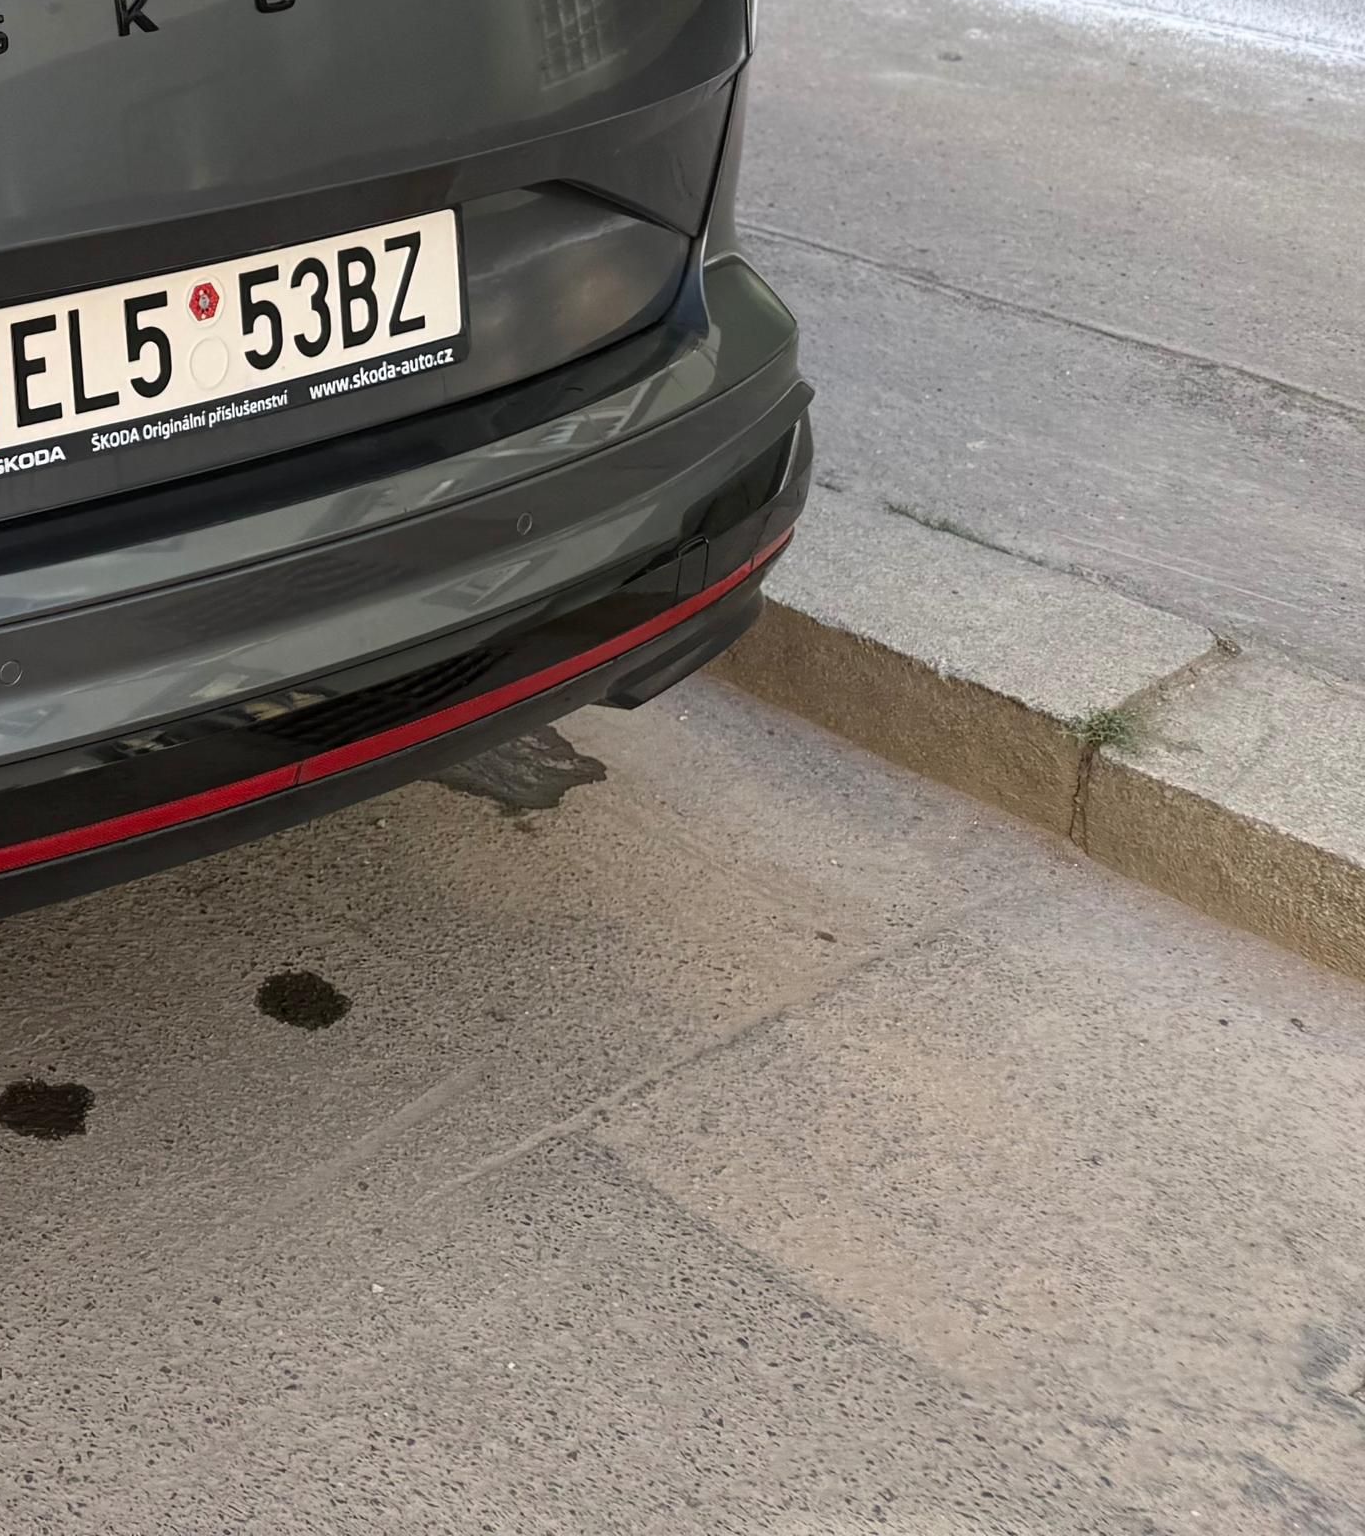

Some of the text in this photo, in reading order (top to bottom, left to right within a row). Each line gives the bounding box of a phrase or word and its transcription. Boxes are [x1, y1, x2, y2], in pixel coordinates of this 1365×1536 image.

[10, 231, 426, 428] EL5 53BZ
[91, 348, 454, 452] ŠKODA Originální příslušenství www.skoda-auto.cz
